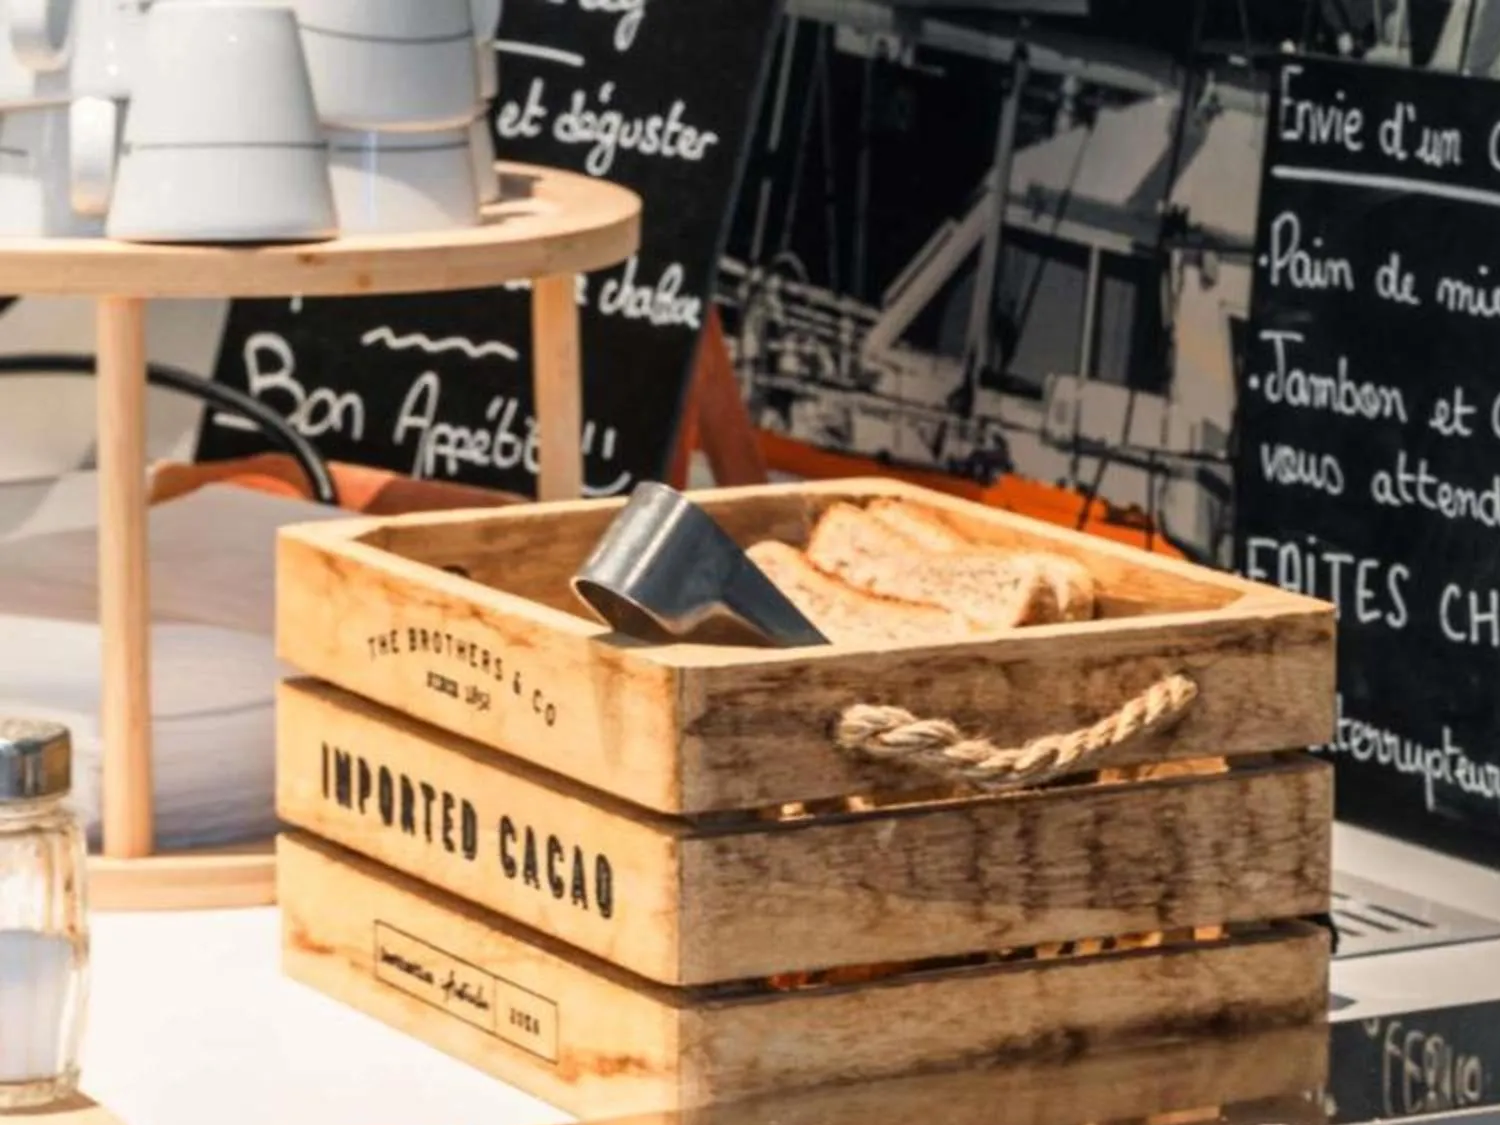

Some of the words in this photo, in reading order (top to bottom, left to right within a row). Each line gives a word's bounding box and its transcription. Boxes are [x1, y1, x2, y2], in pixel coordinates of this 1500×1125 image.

[496, 77, 548, 138] et
[1279, 64, 1365, 152] Envie
[1379, 101, 1464, 168] d'un
[1375, 252, 1421, 306] de
[242, 332, 366, 443] Bon
[1429, 386, 1478, 437] et
[1259, 442, 1345, 497] vous
[366, 628, 401, 664] THE
[407, 626, 504, 682] BROTHERS
[532, 687, 558, 728] CO
[321, 740, 479, 862] IMPORTED
[498, 814, 615, 921] CACAO
